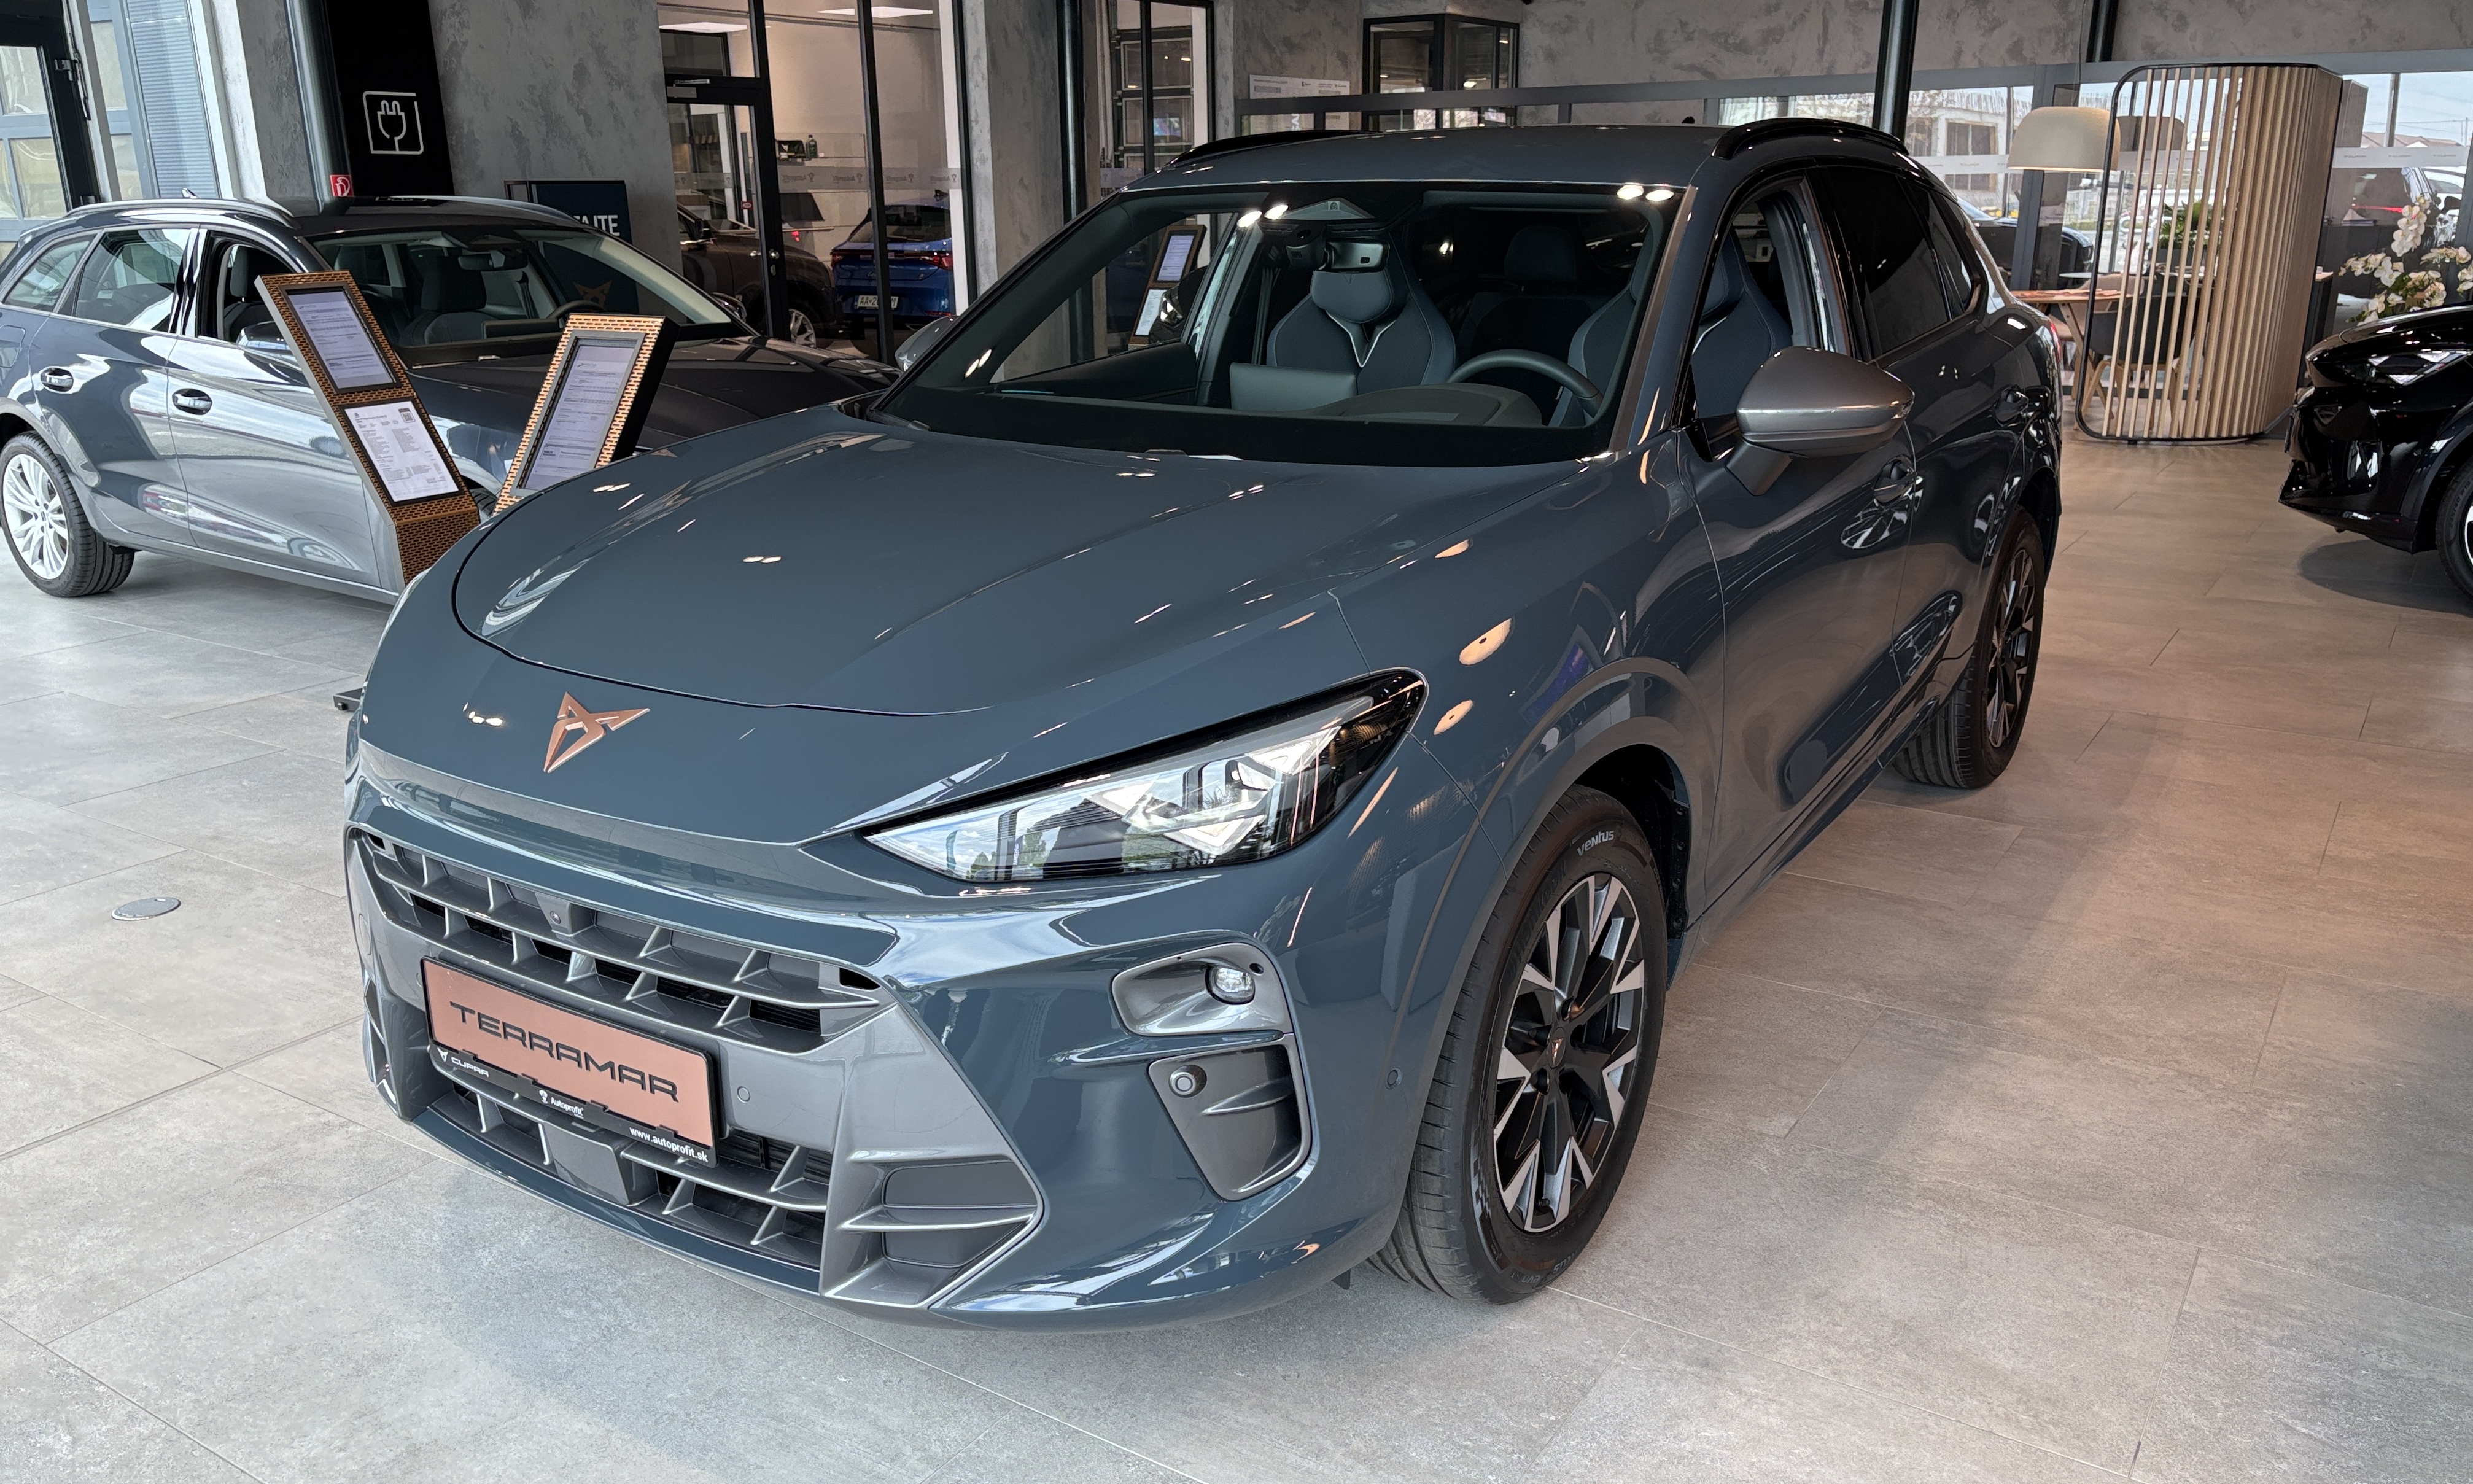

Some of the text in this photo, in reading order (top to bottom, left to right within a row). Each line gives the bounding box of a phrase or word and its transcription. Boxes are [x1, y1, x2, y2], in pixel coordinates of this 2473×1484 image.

[449, 1001, 679, 1103] TERRAMAR
[451, 1056, 489, 1078] CUPRA
[551, 1097, 584, 1116] Autoprofit
[629, 1127, 709, 1163] www.autoprofit.sk
